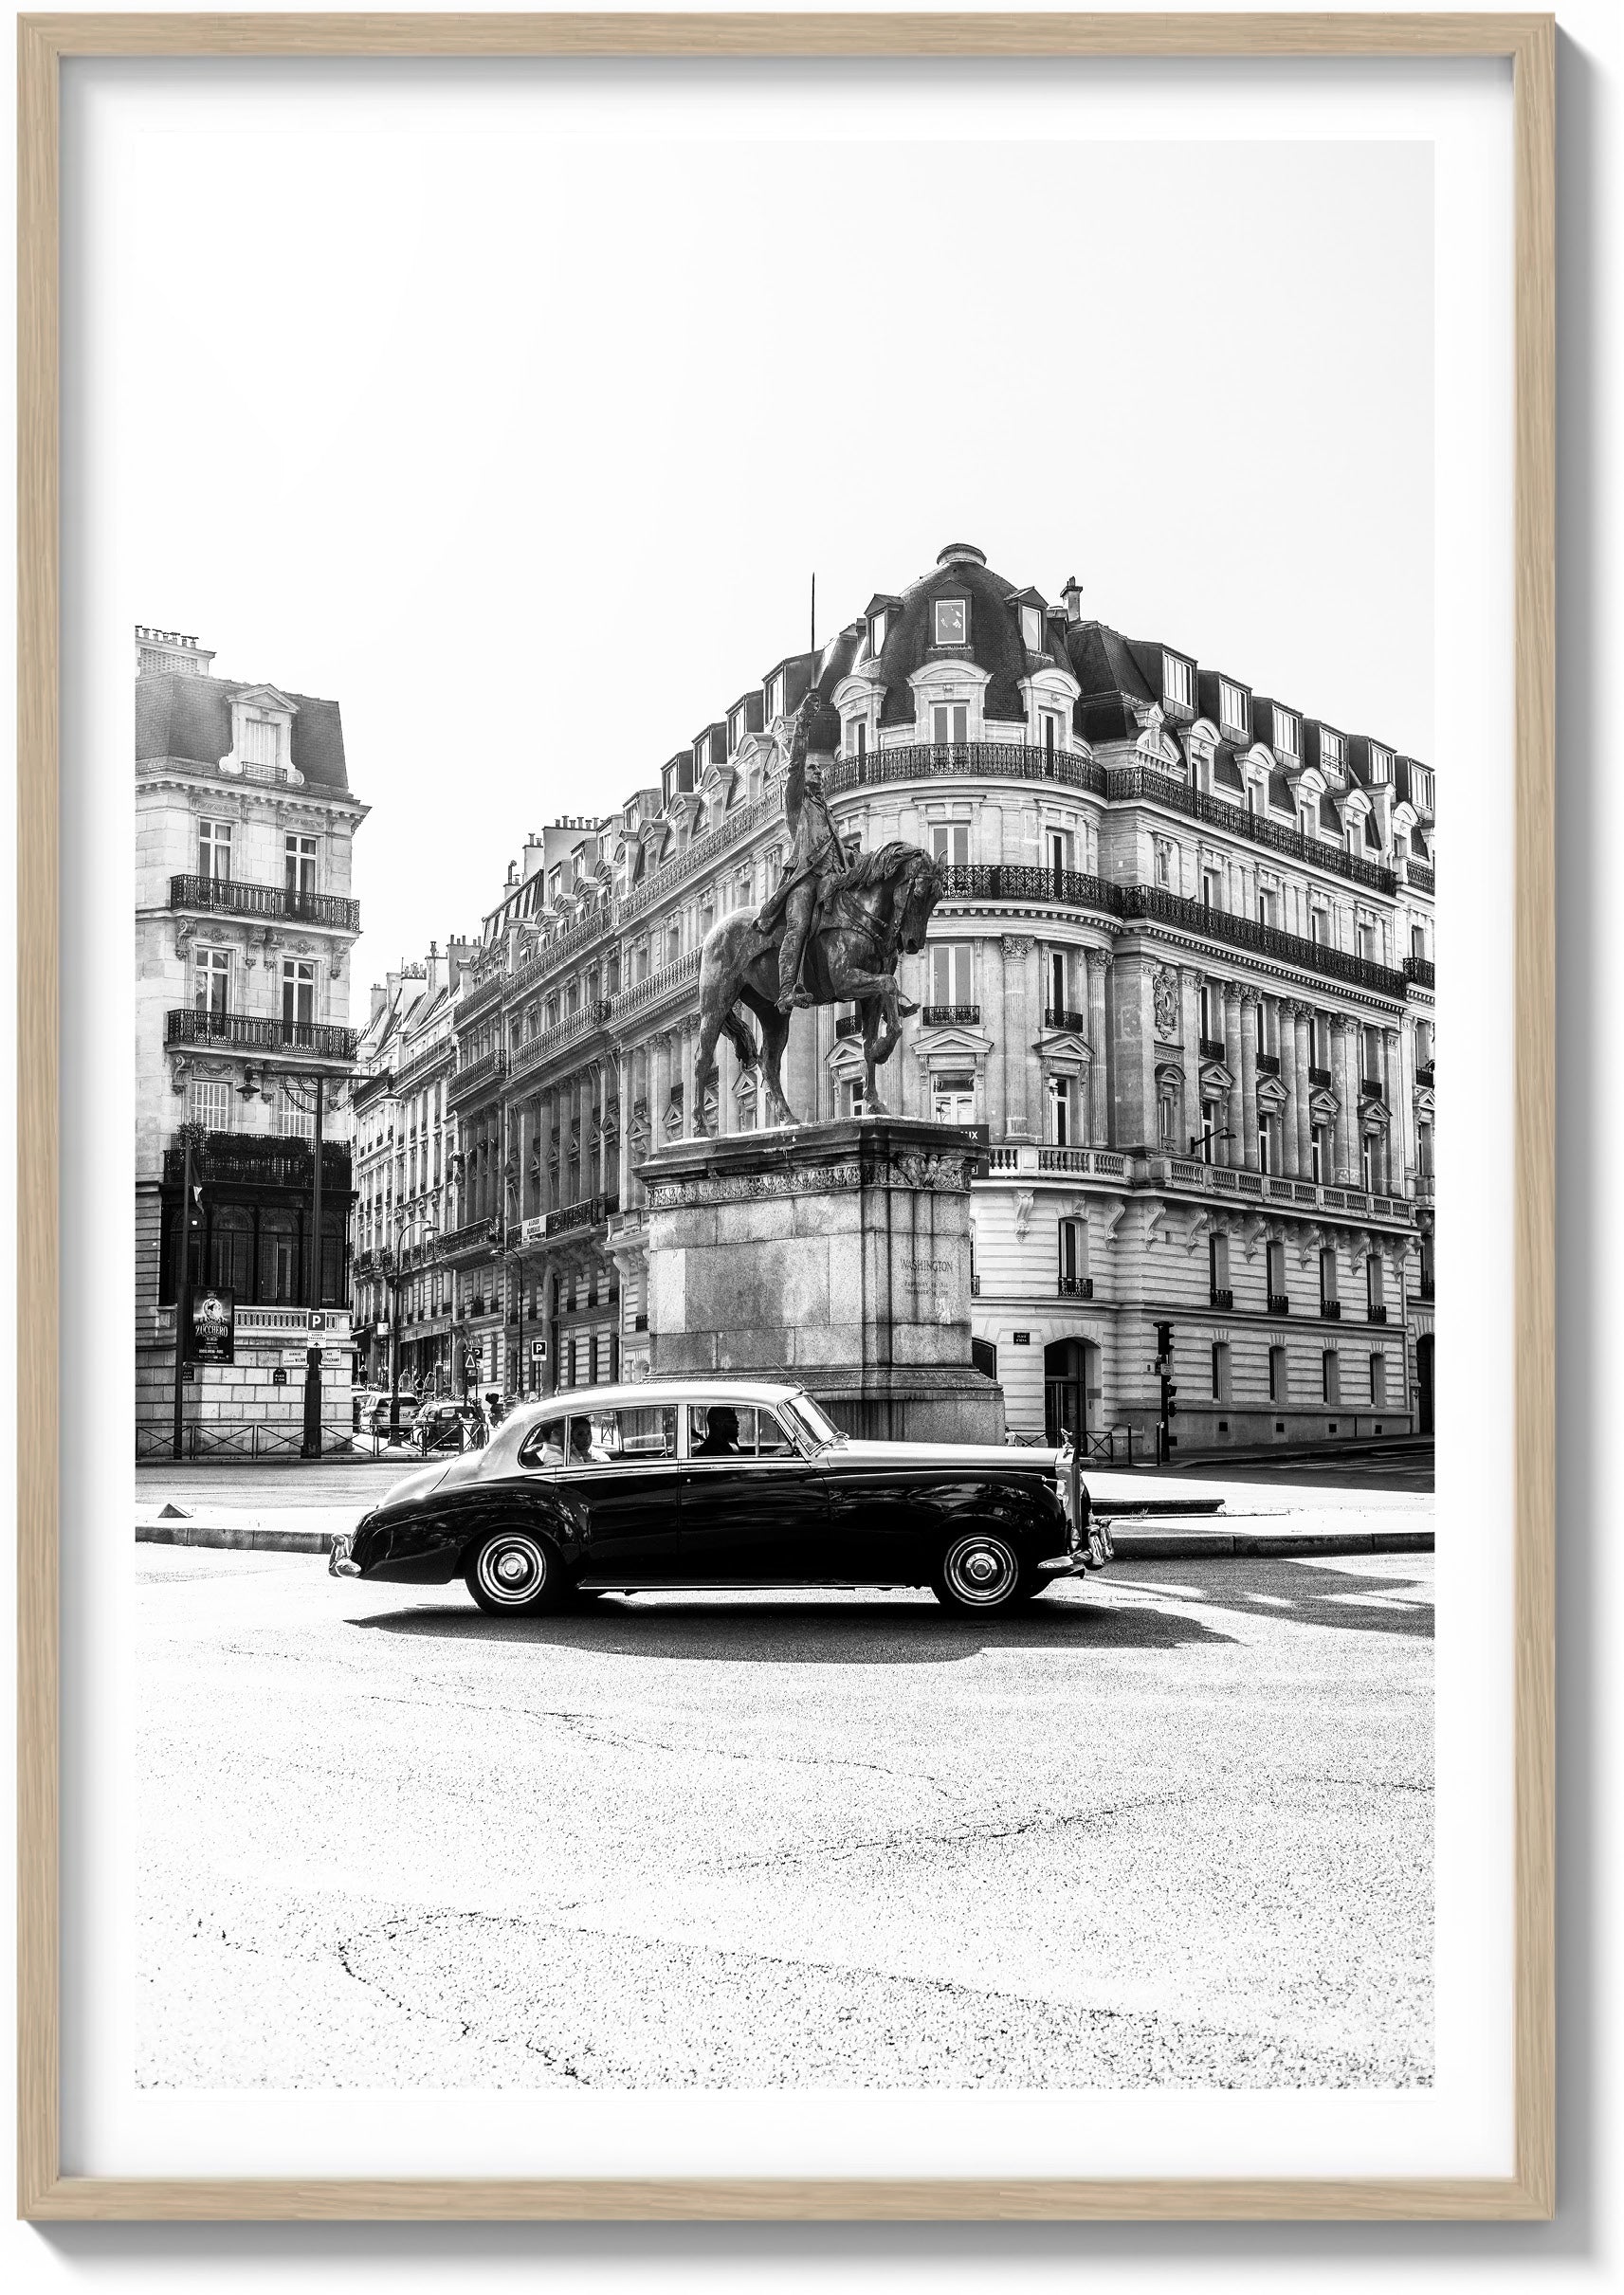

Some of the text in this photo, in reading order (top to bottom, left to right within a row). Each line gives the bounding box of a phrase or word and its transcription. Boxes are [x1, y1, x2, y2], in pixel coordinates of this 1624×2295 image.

[901, 1259, 953, 1271] WASHINGTON
[312, 1315, 321, 1328] P
[194, 1323, 228, 1338] ZUCCHERO
[536, 1343, 543, 1354] P
